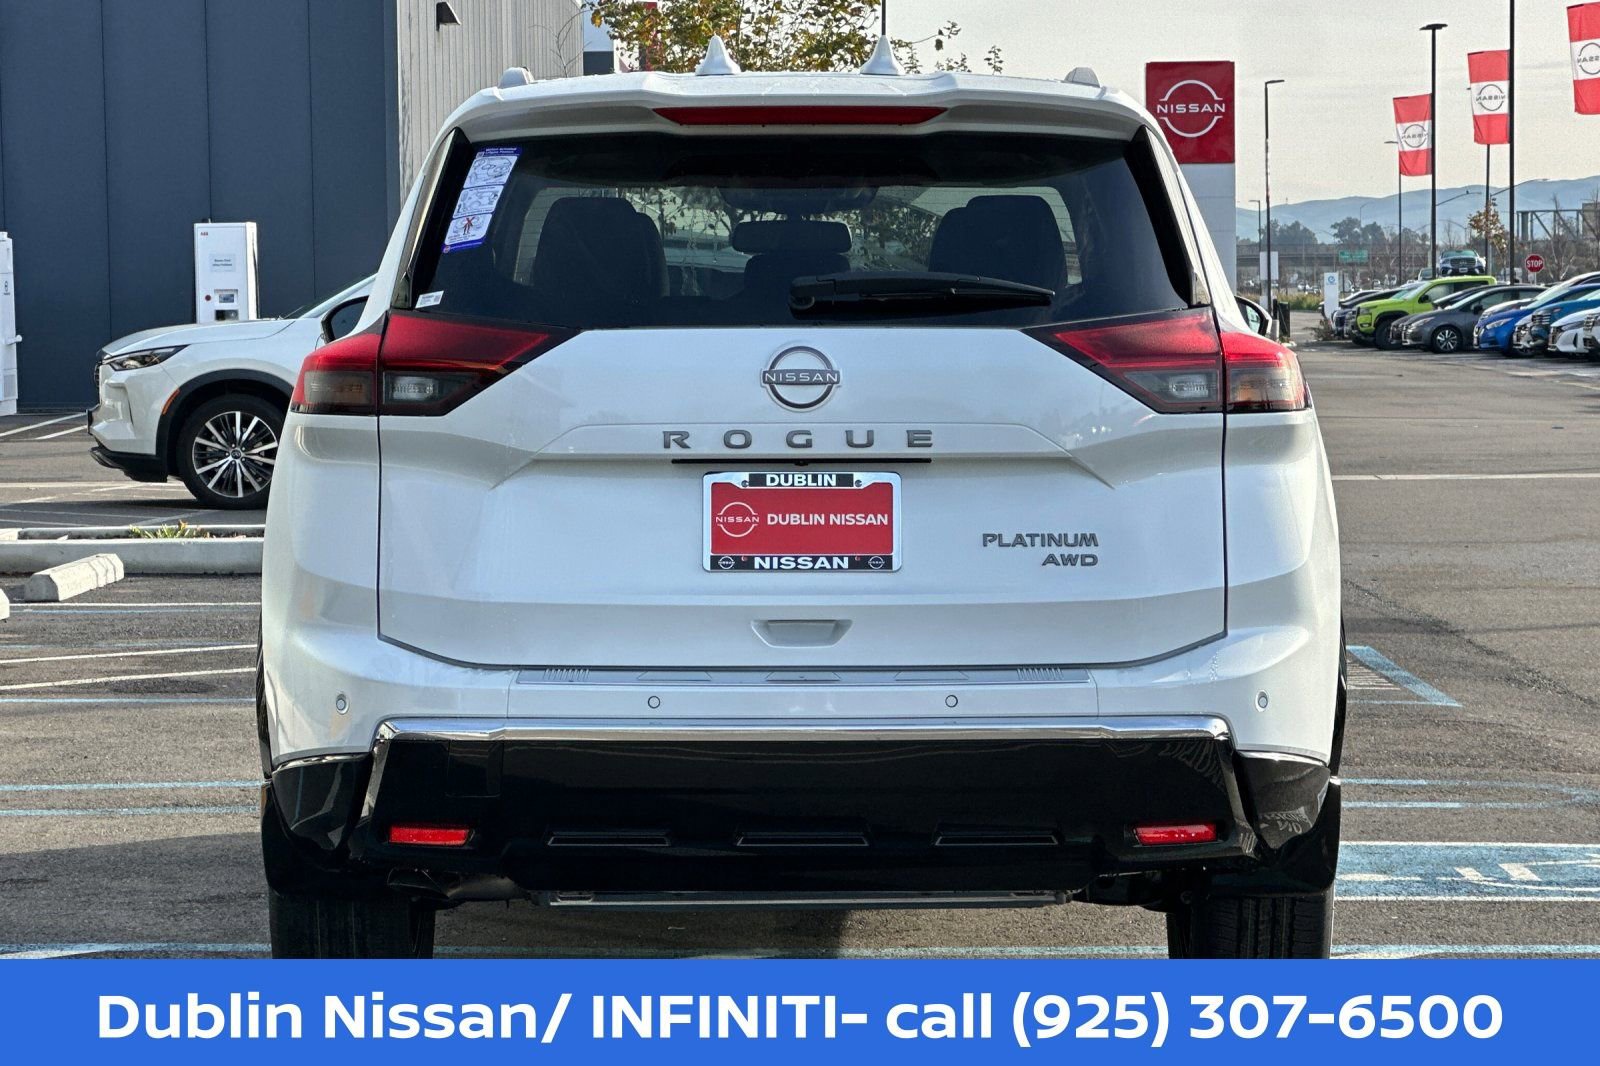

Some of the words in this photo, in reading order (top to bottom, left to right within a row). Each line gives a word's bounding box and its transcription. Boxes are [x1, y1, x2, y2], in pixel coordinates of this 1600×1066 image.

[1157, 103, 1226, 113] NISSAN
[1526, 260, 1543, 268] STOP
[765, 372, 838, 383] NISSAN
[662, 429, 933, 449] ROGUE
[765, 473, 837, 487] DUBLIN
[767, 513, 825, 525] DUBLIN
[829, 513, 888, 525] NISSAN
[982, 533, 1099, 547] PLATINUM
[754, 556, 849, 569] NISSAN
[1041, 553, 1099, 566] AWD
